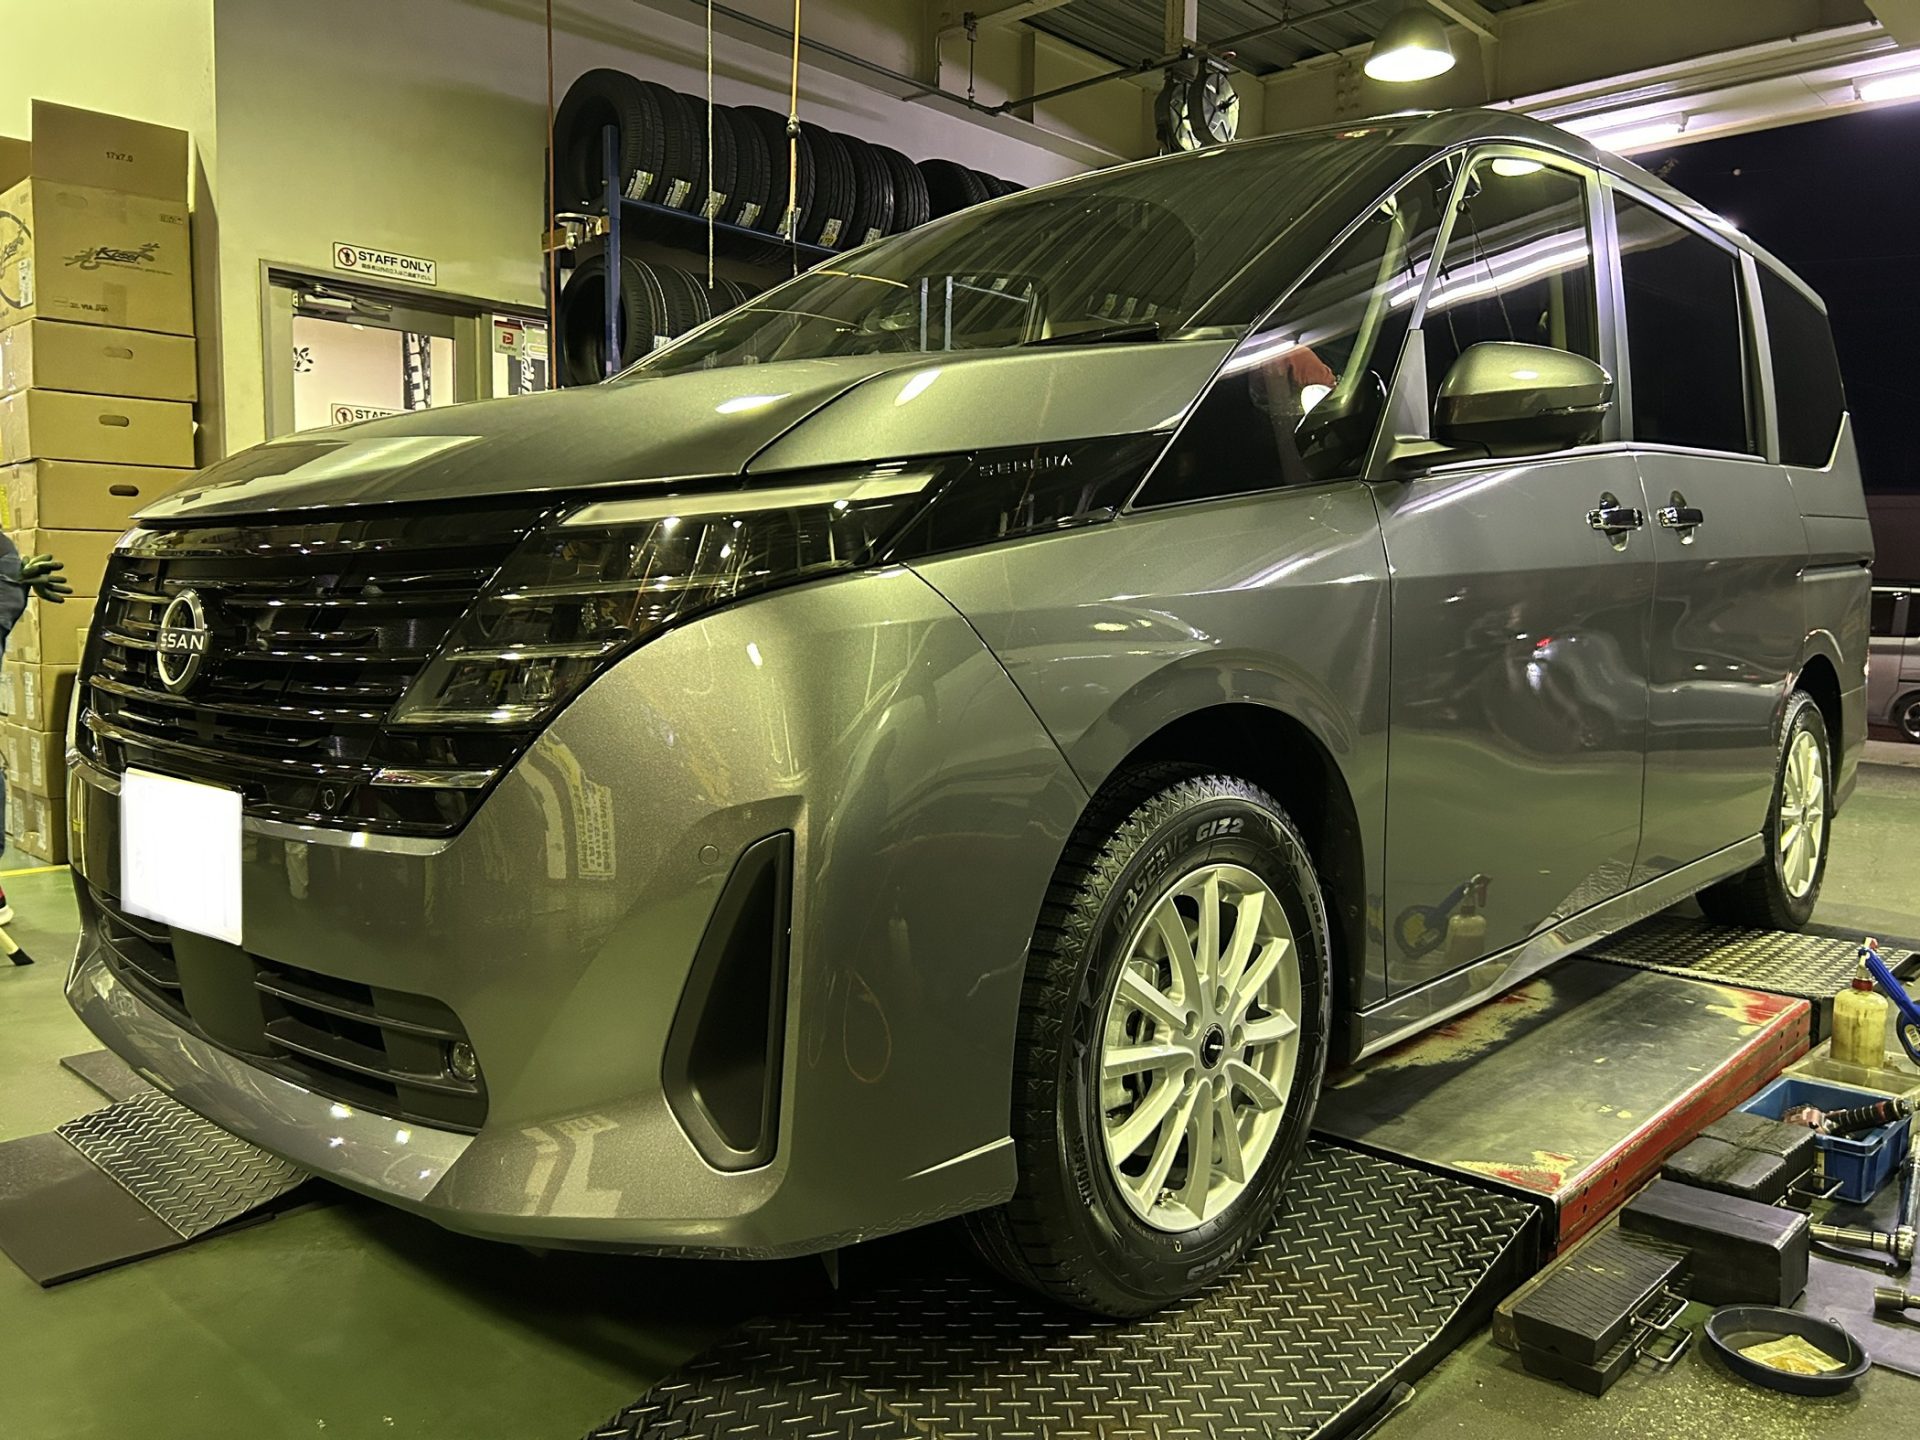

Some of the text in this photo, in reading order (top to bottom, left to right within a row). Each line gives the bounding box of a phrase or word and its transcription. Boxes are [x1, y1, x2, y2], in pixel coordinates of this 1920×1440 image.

[358, 250, 433, 273] STAFF ONLY
[355, 410, 393, 419] STA
[160, 632, 204, 650] SSAN
[1195, 816, 1245, 843] GIZ2
